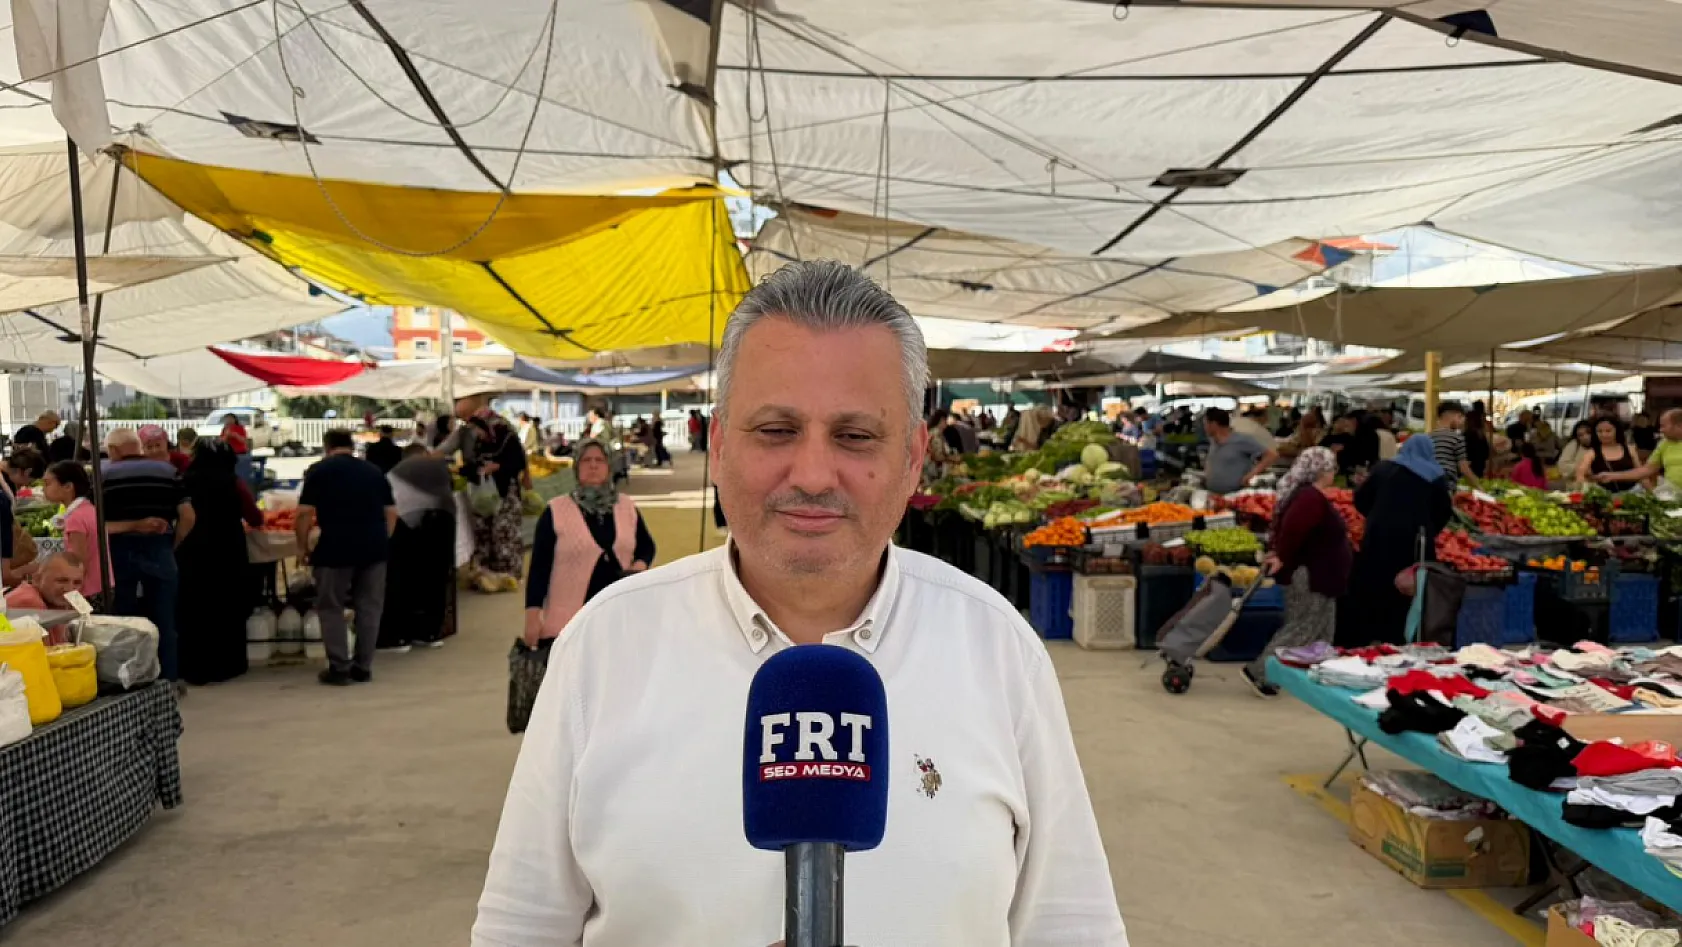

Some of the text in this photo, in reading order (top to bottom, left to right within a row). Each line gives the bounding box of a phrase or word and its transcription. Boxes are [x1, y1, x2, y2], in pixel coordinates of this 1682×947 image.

[759, 712, 872, 763] FRT
[763, 764, 866, 778] SED MEDYA
